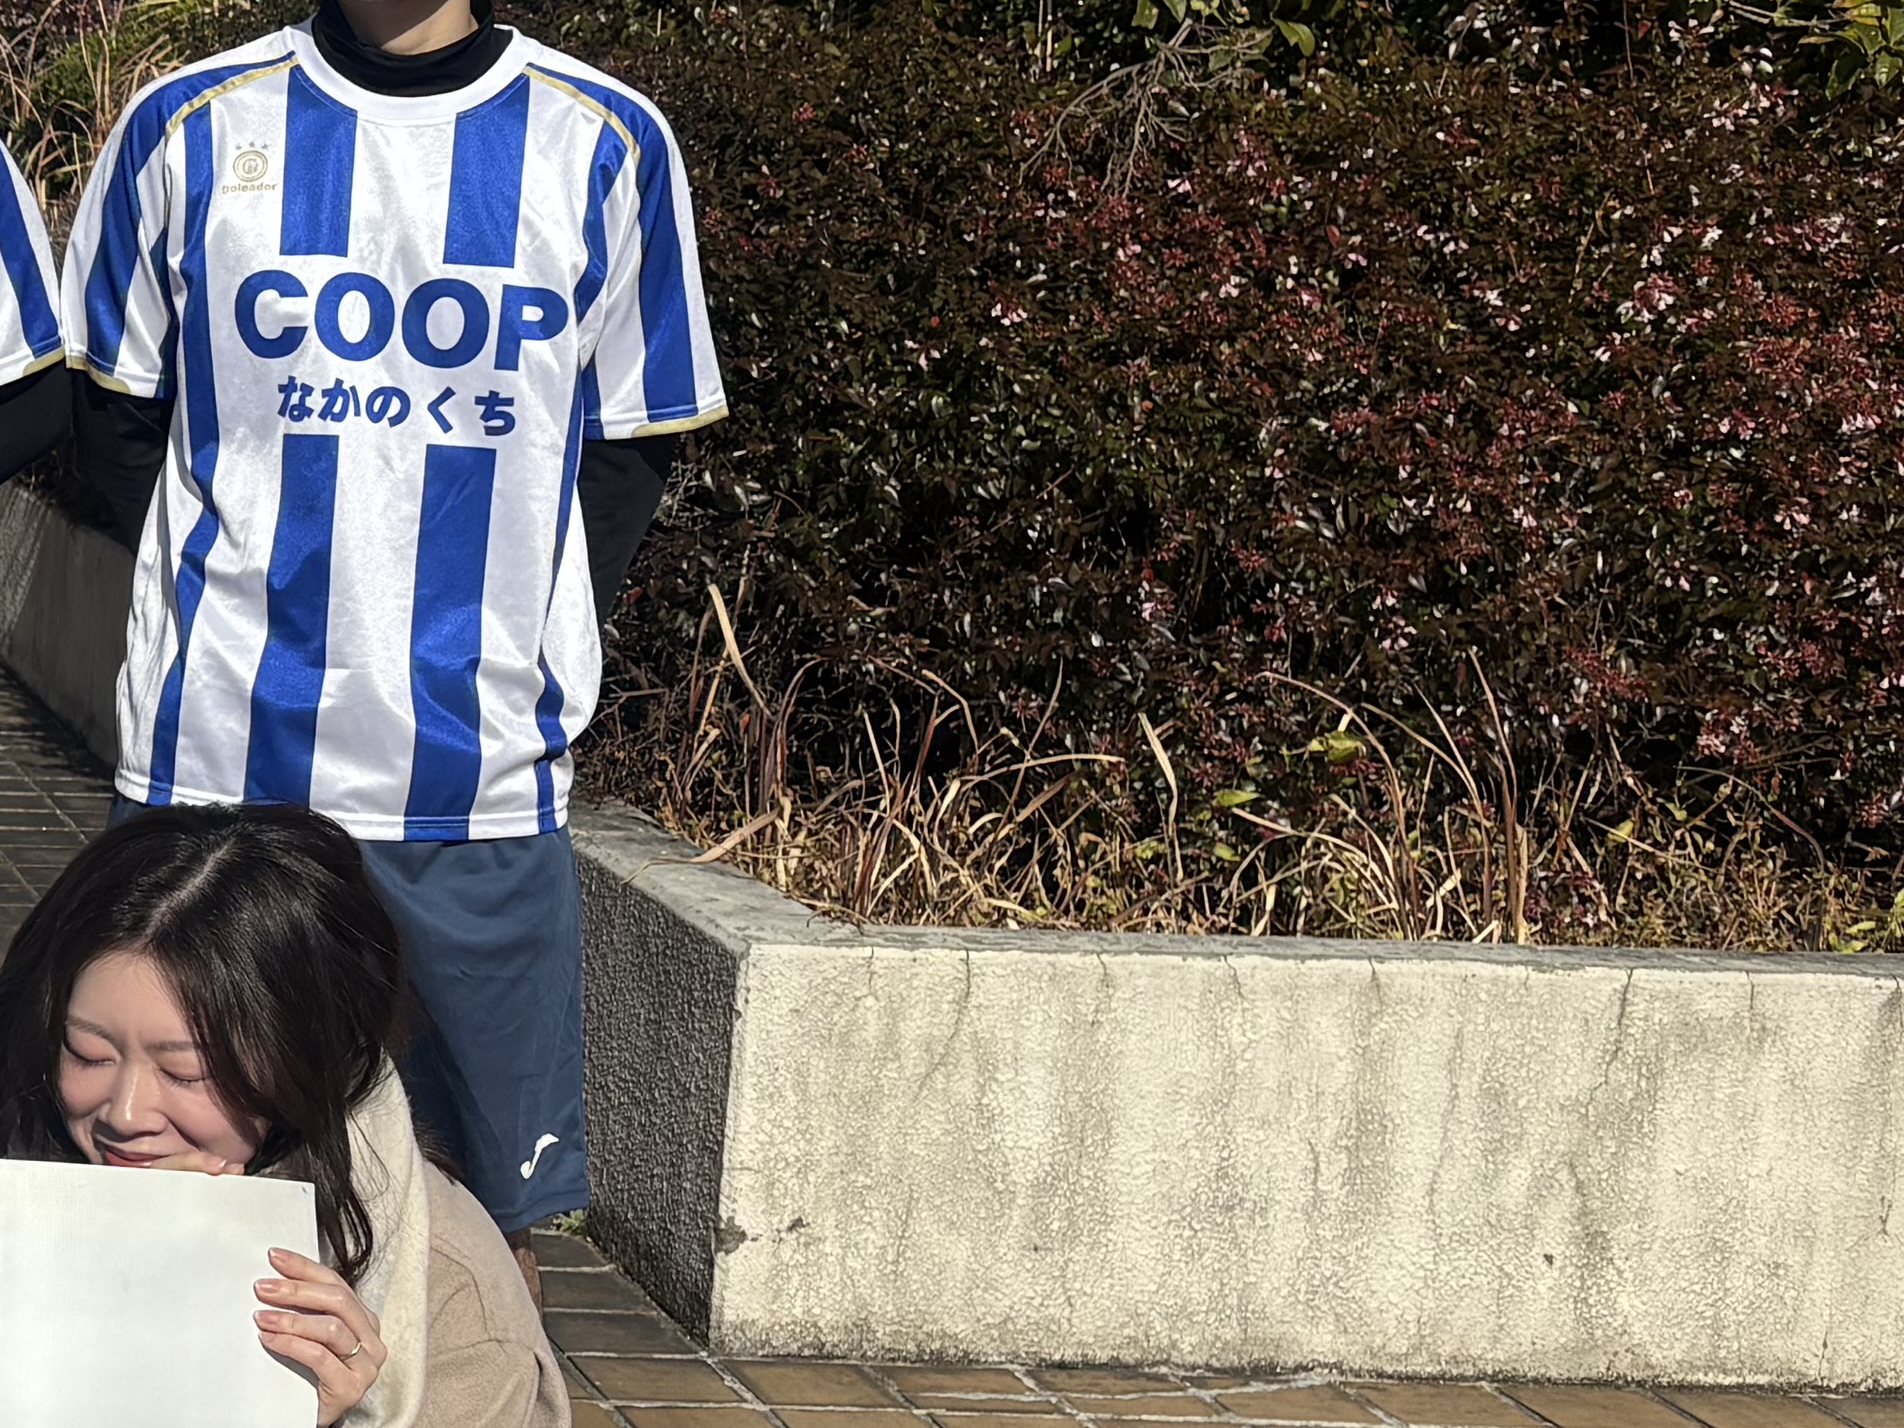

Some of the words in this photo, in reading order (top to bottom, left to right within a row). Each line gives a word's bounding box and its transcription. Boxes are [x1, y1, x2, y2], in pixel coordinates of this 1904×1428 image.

[235, 269, 569, 371] COOP
[277, 375, 516, 436] なかのくち
